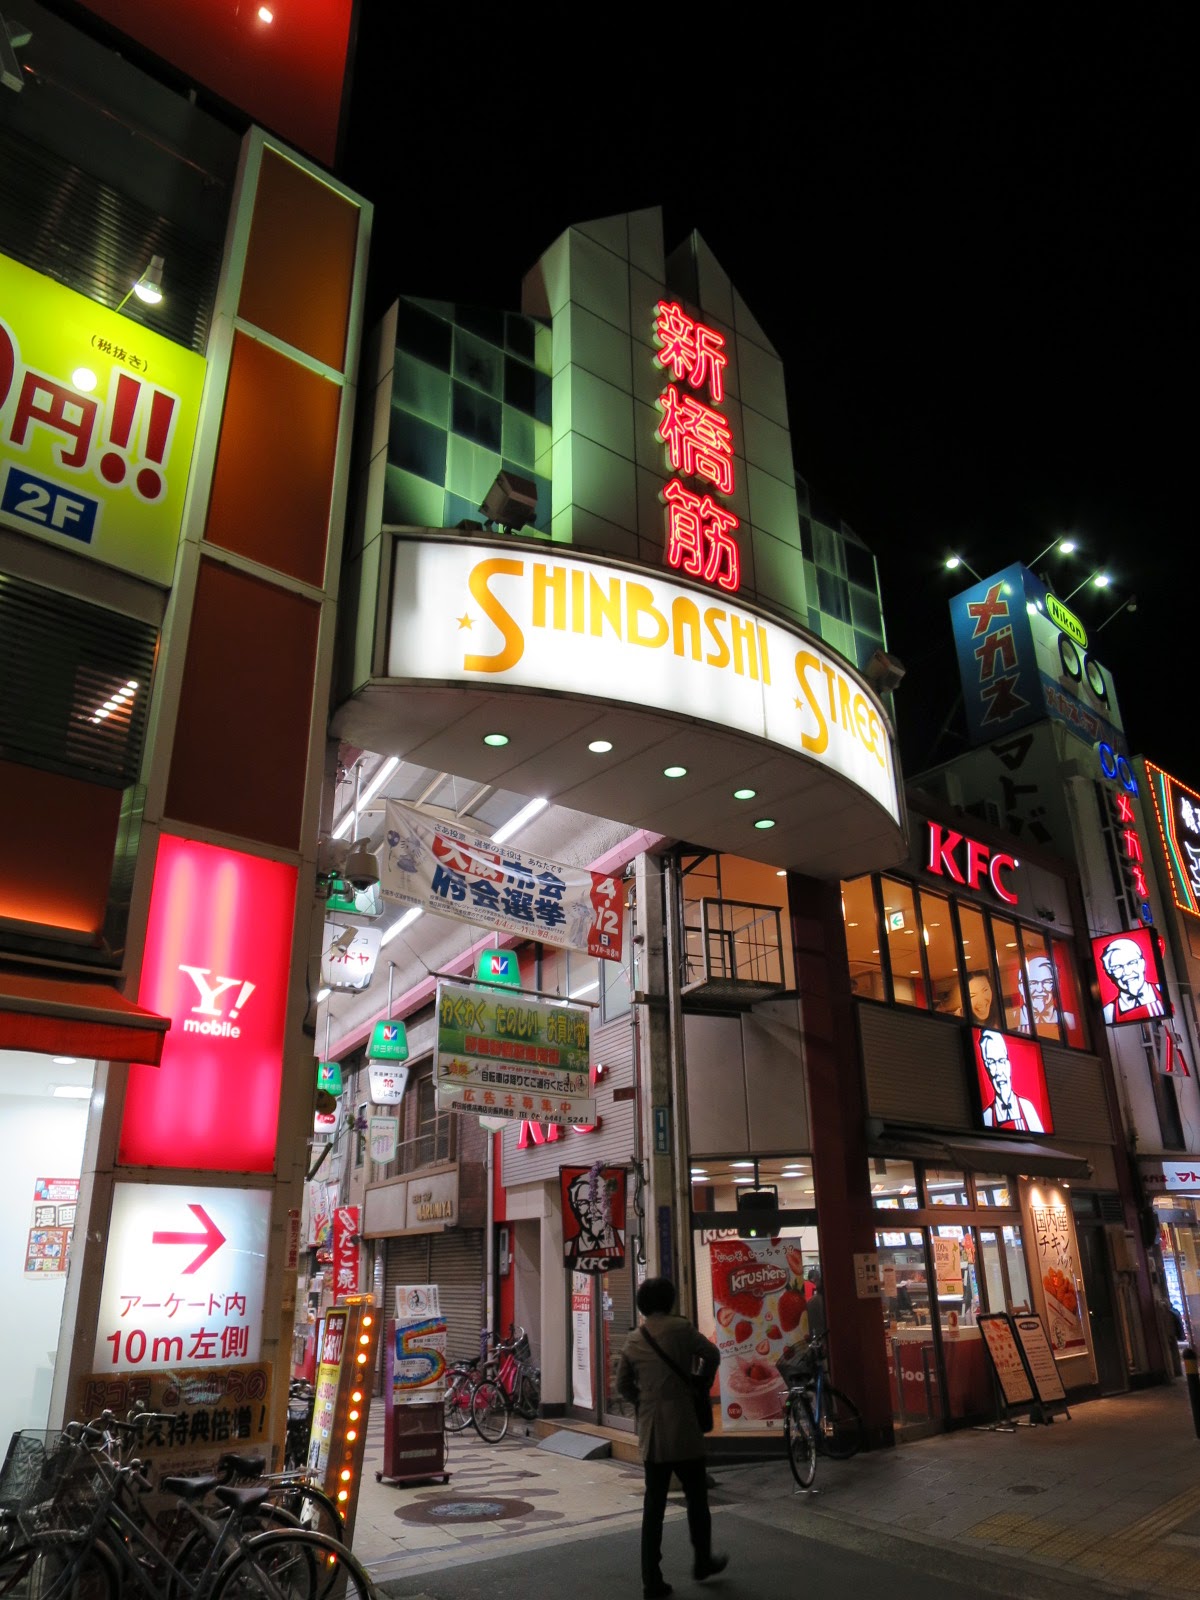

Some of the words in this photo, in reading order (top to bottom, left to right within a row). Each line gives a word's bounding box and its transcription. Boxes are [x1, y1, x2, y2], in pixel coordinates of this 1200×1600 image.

[655, 300, 741, 592] 新橋筋
[14, 483, 85, 529] 2F
[463, 558, 772, 673] SHINBASHI
[1051, 601, 1083, 640] Nikon
[967, 579, 1031, 727] メガネ
[527, 858, 565, 874] あなたです
[927, 820, 1019, 905] KFC
[430, 863, 567, 928] 府会選挙
[178, 964, 256, 1019] Y!
[184, 1017, 241, 1038] mobile
[441, 995, 486, 1033] わくわく
[495, 1003, 539, 1038] たのしい
[547, 1014, 587, 1048] お買い物
[481, 1070, 576, 1093] 自転車は降りてご通行ください
[463, 1088, 572, 1115] 広告主募集中
[519, 1111, 528, 1120] TEL
[1034, 1208, 1069, 1233] 国内産
[1038, 1232, 1071, 1257] チキン
[574, 1255, 611, 1271] KFC
[1056, 1254, 1074, 1270] パック
[731, 1265, 788, 1292] Krushers
[119, 1291, 247, 1319] アーケード内
[106, 1325, 250, 1365] 10m左側
